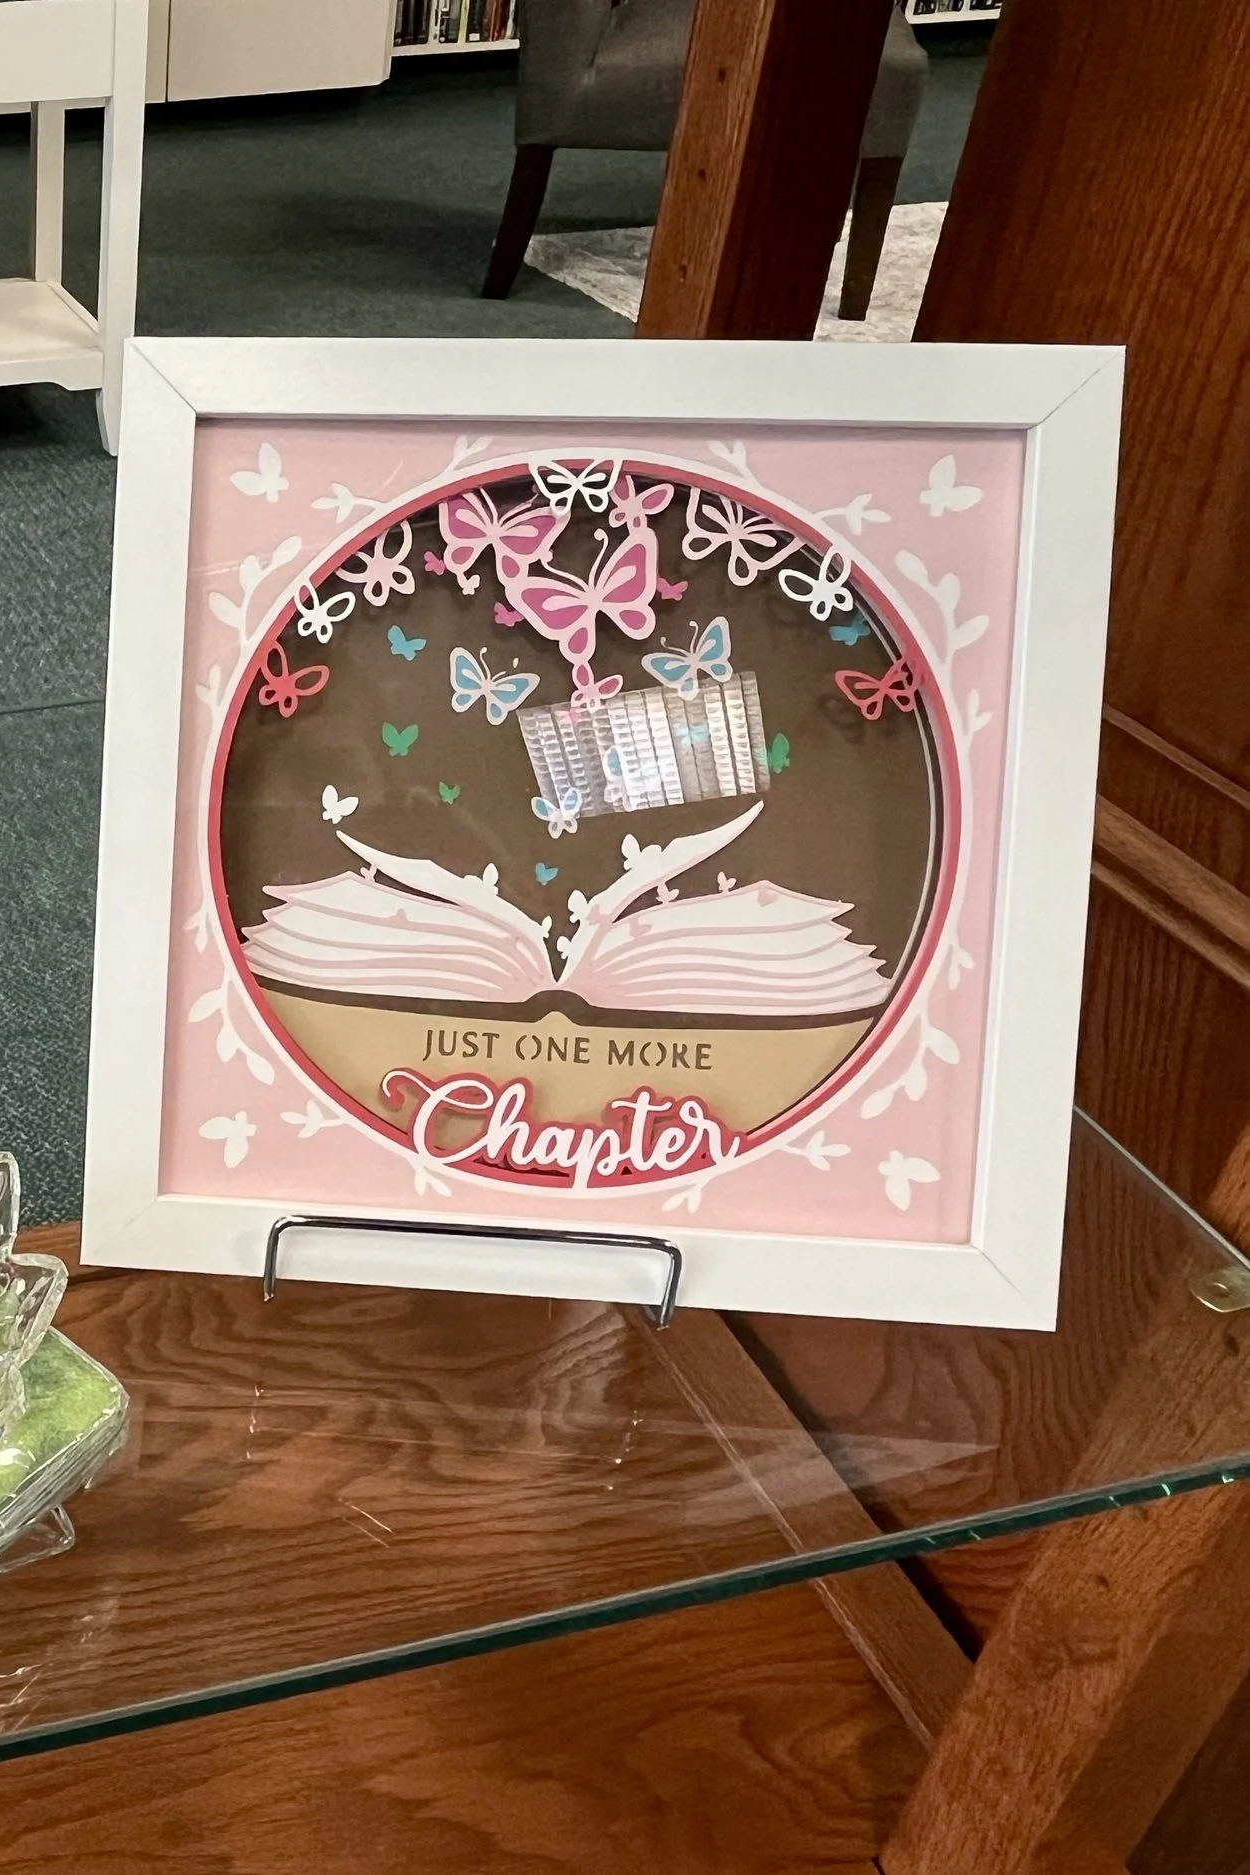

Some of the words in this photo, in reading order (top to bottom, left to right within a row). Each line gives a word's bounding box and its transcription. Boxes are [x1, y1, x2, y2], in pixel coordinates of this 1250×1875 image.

[422, 1029, 500, 1062] JUST
[515, 1034, 591, 1064] ONE
[608, 1040, 713, 1070] MORE
[381, 1070, 741, 1189] Chapter
